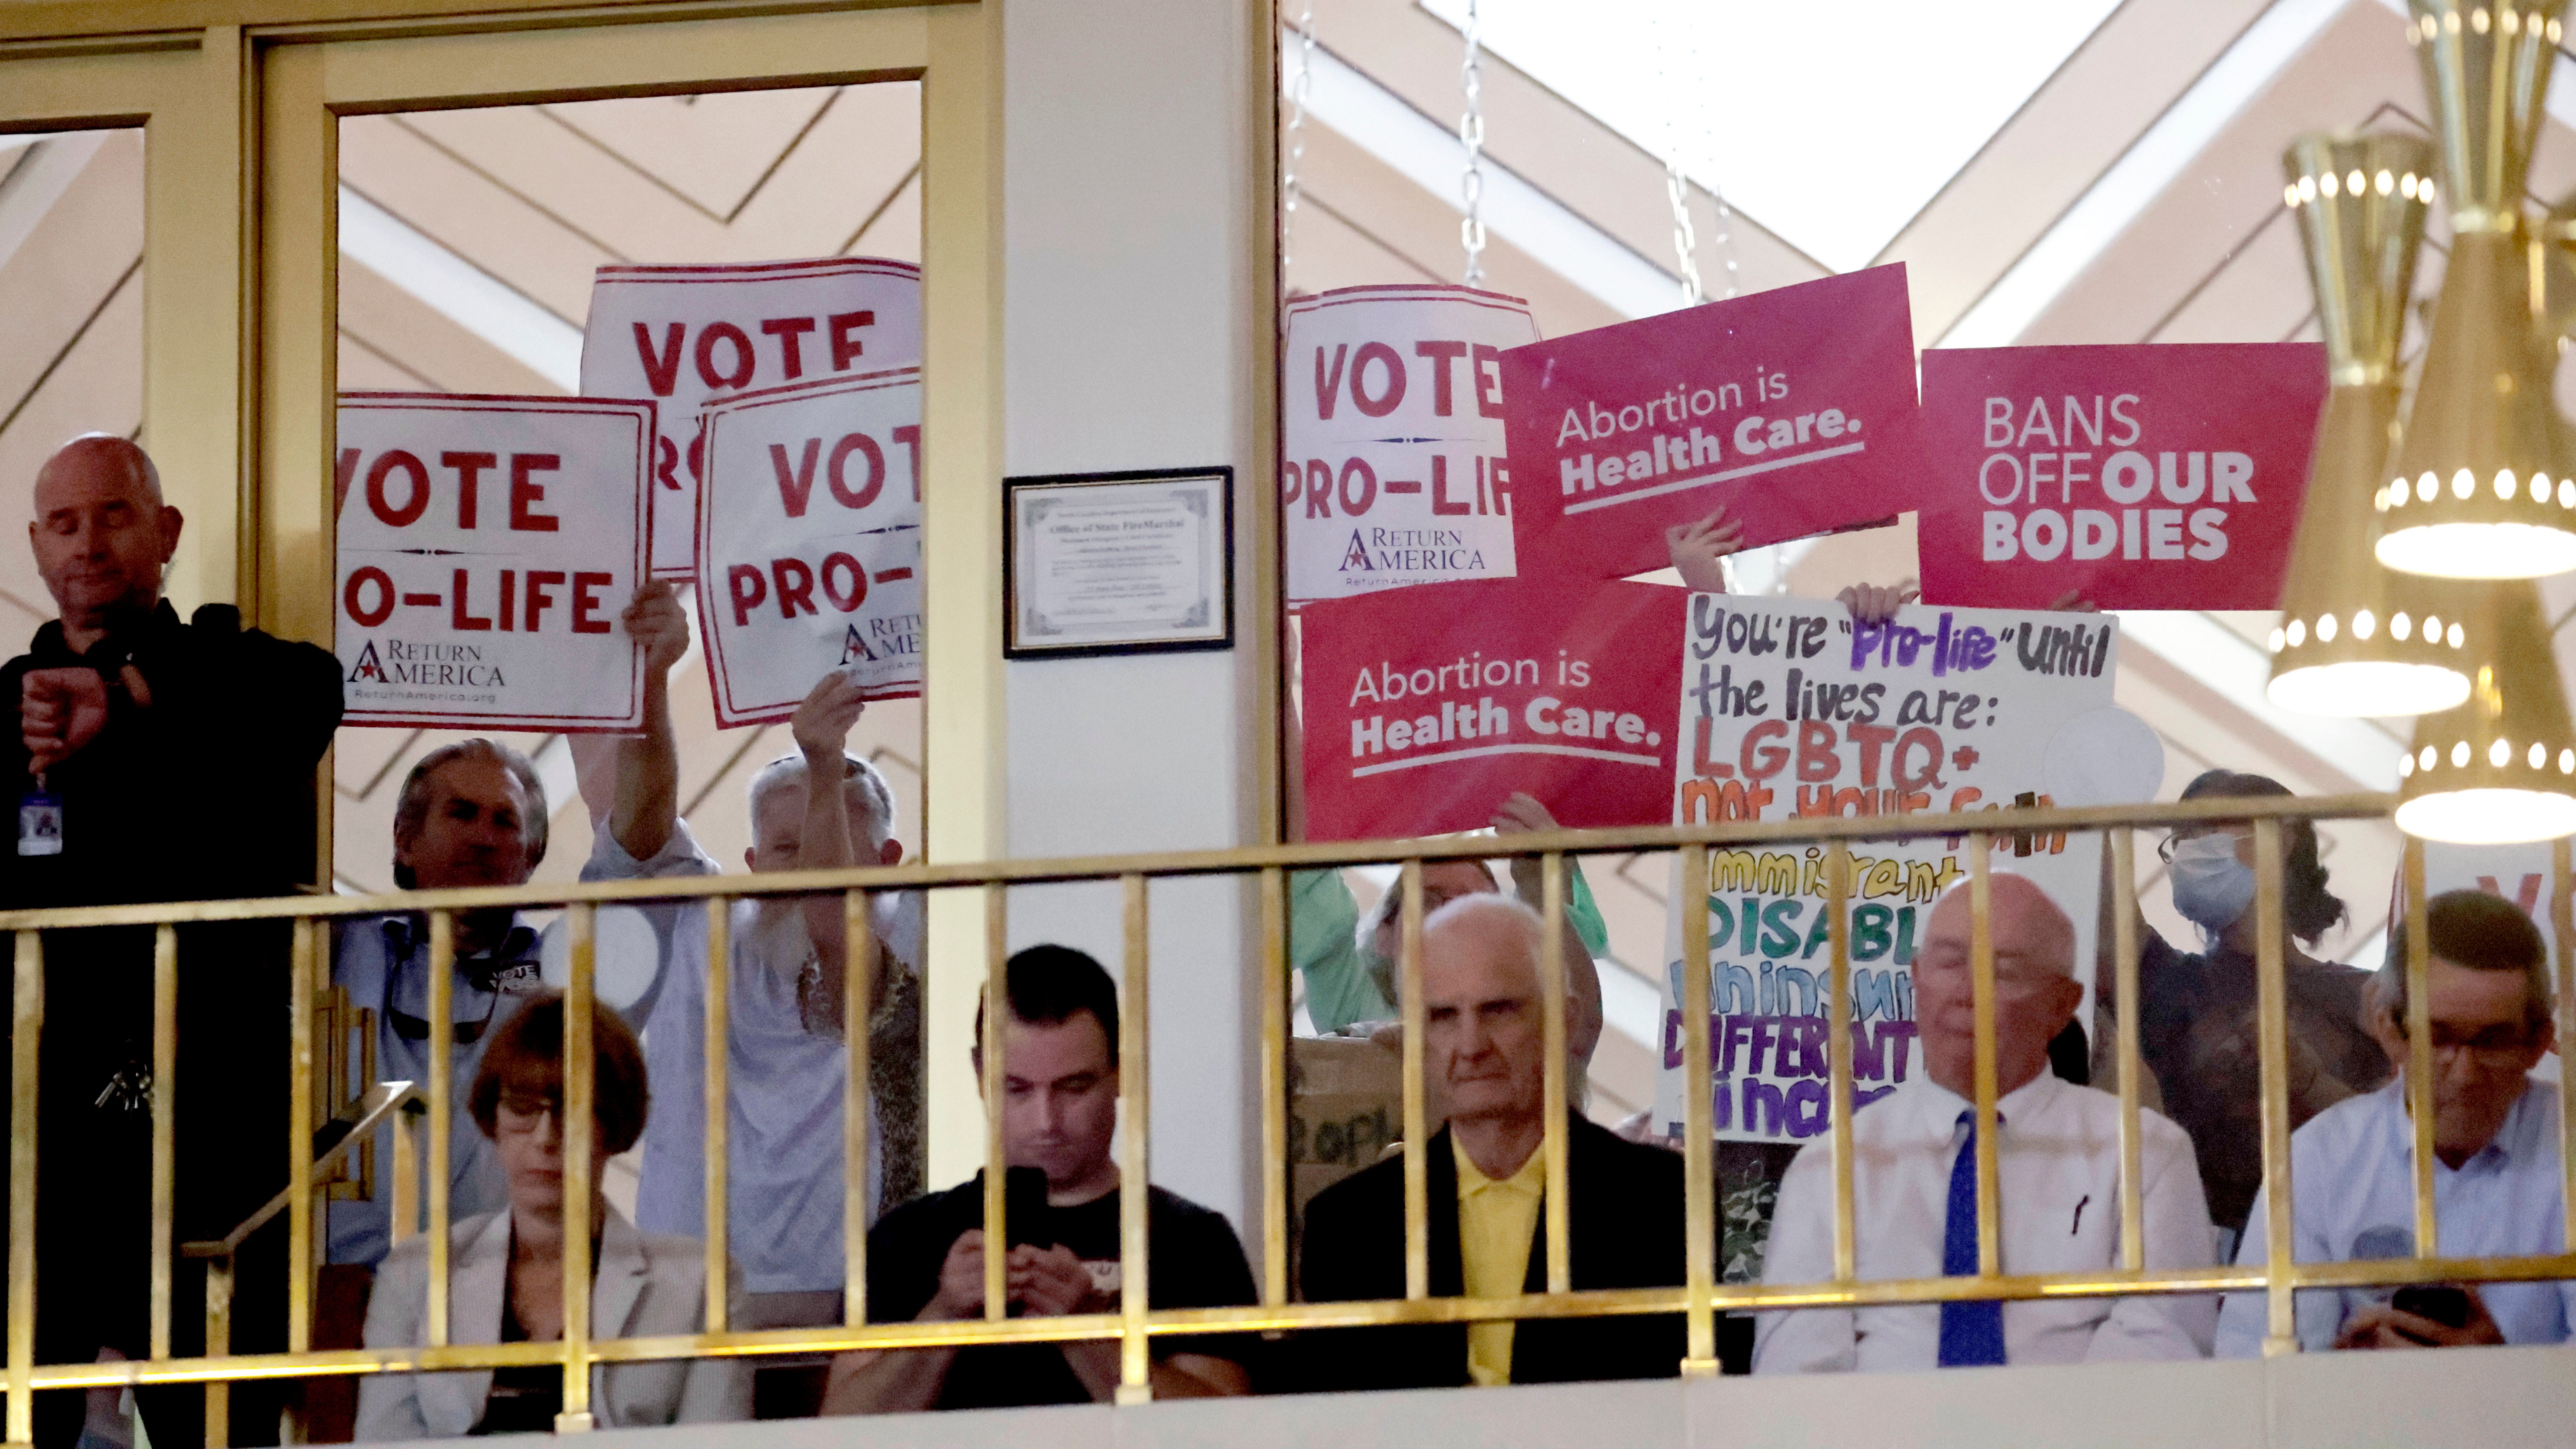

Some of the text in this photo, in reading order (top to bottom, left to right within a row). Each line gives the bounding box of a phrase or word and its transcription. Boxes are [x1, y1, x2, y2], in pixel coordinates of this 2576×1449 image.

[1315, 341, 1504, 420] VOTE
[1556, 366, 1788, 447] Abortion is
[1560, 407, 1861, 495] Health Care.
[1984, 393, 2141, 448] BANS
[769, 424, 920, 518] VOT
[1285, 455, 1510, 519] PRO-LIF
[1979, 450, 2257, 505] OFF OUR
[1338, 528, 1486, 571] AMERICA
[1372, 527, 1463, 547] RETURN
[1983, 508, 2229, 562] BODIES
[343, 566, 612, 634] O-LIFE
[728, 551, 913, 626] PRO-
[347, 639, 506, 686] AMERICA
[388, 639, 482, 661] RETURN
[1349, 650, 1591, 707] Abortion is
[1351, 696, 1661, 758] Health Care.
[1690, 663, 1999, 730] the lives are:
[1693, 715, 1980, 791] LGBTQ+
[1708, 895, 1918, 967] DISABL
[492, 964, 536, 979] VOTE
[1664, 1008, 1918, 1084] DIFFERNT
